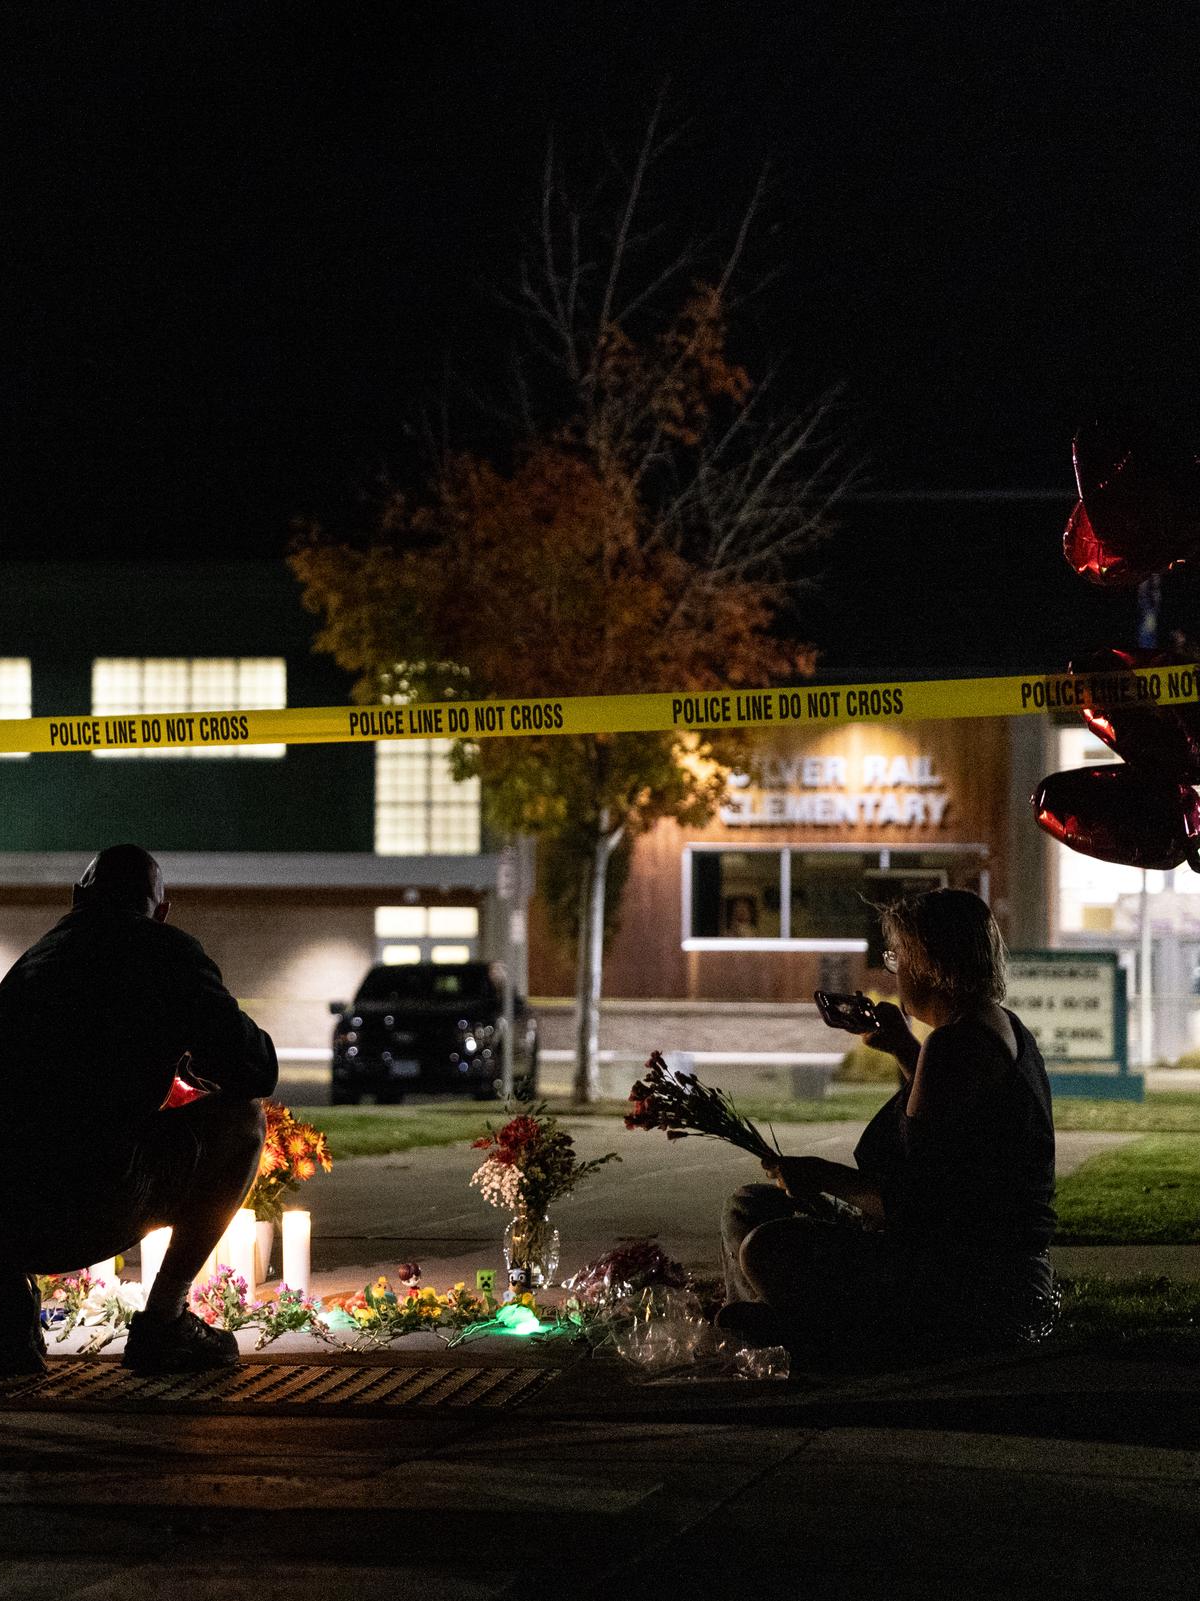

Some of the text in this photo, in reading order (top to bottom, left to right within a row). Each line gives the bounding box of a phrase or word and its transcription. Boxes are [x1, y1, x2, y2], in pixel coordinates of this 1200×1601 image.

[672, 688, 904, 724] POLICE LINE DO NOT CROSS
[1021, 679, 1086, 708] POLICE
[1136, 673, 1161, 699] DO
[50, 715, 249, 746] POLICE LINE DO NOT CROSS
[350, 703, 564, 736] POLICE LINE DO NOT CROSS
[863, 754, 942, 787] RAIL
[720, 792, 950, 825] ELEMENTARY
